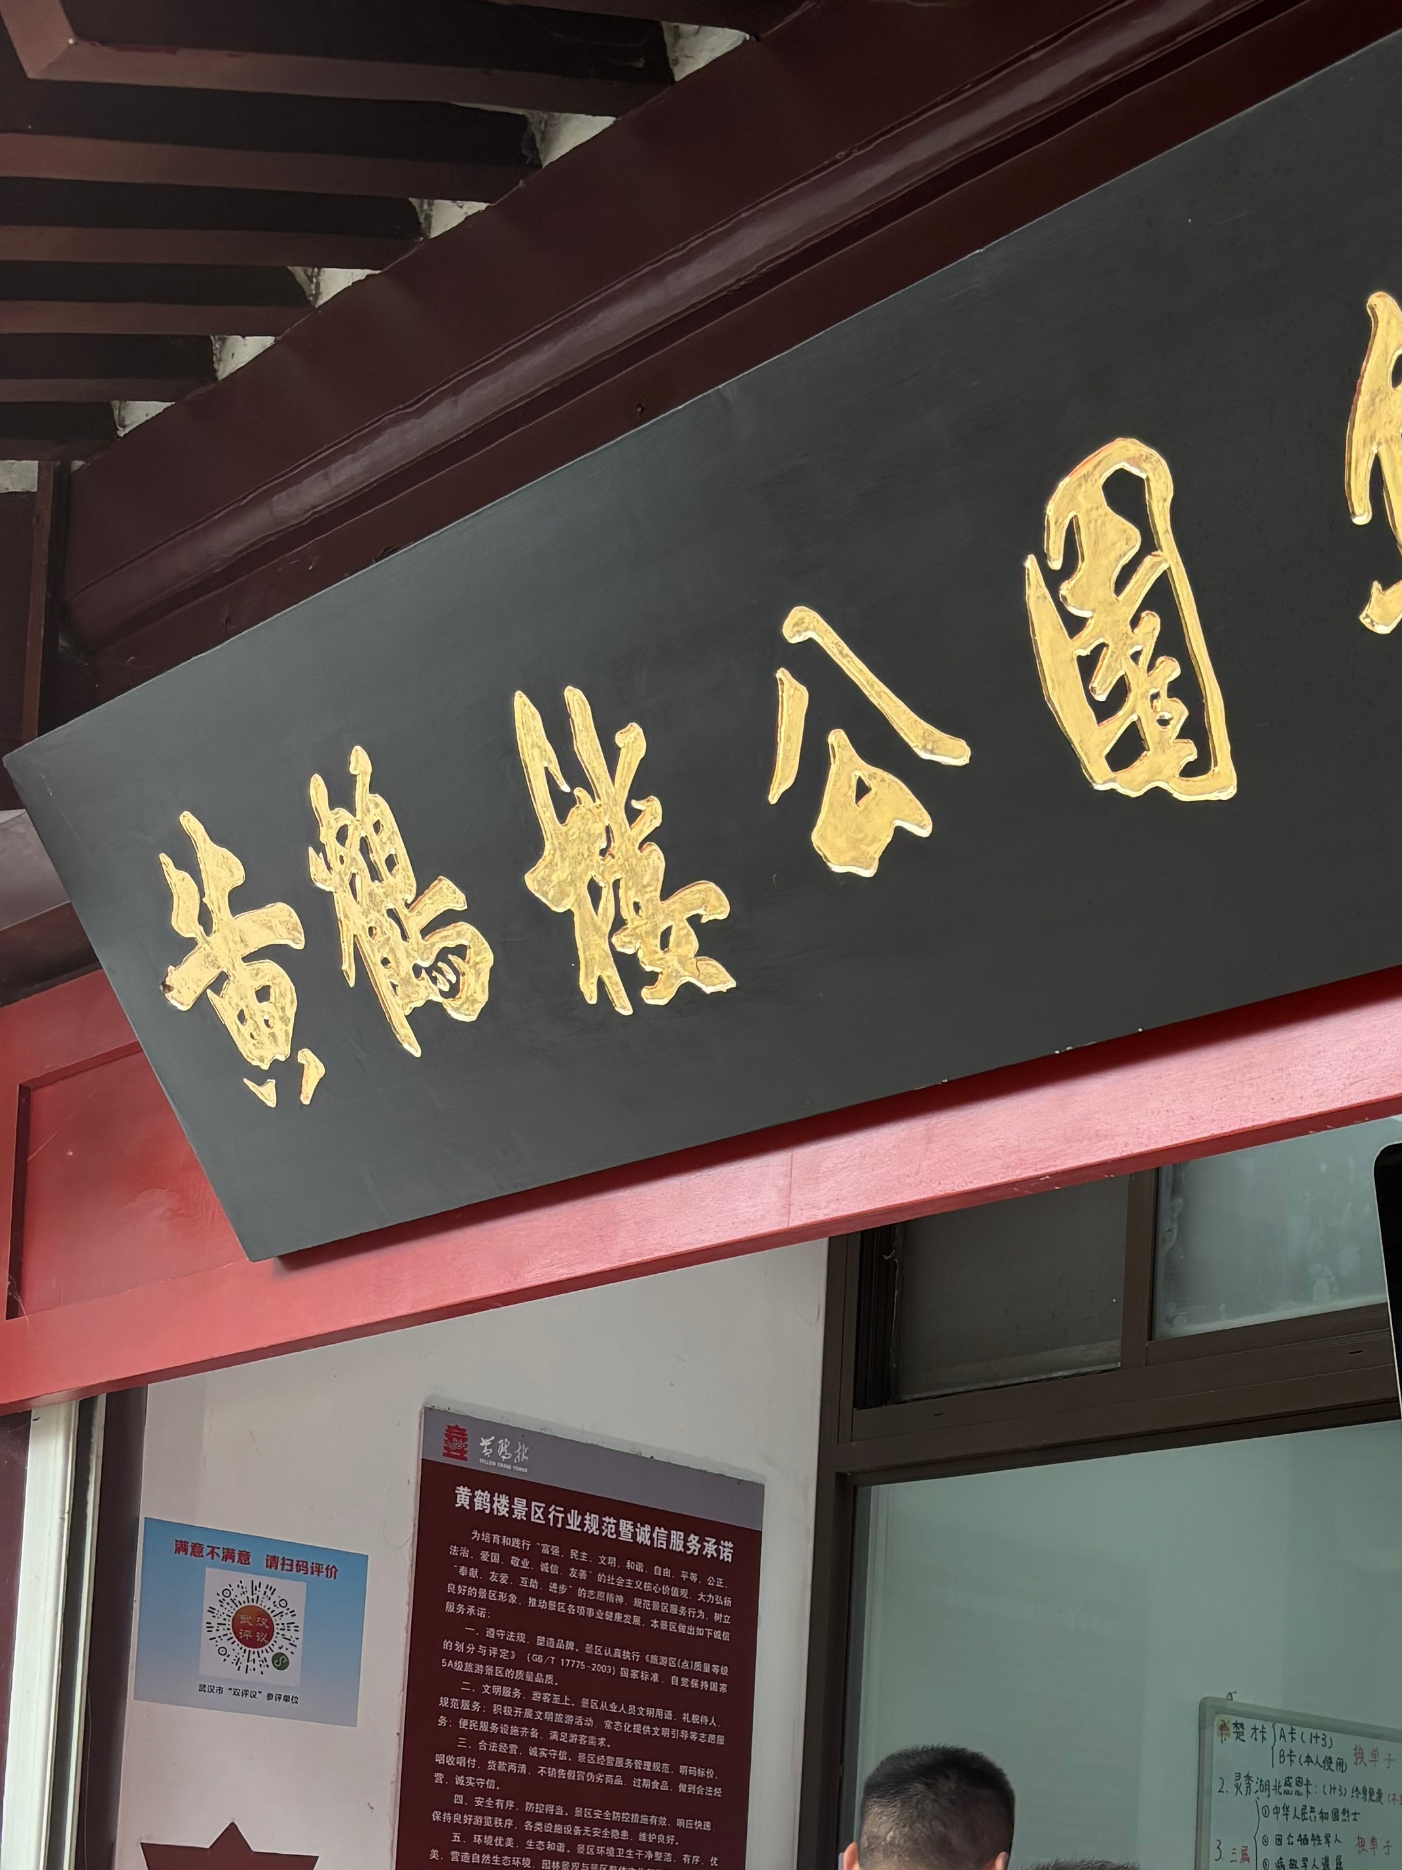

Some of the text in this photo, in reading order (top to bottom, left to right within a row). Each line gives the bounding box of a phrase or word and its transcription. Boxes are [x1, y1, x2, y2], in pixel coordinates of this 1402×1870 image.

[453, 1484, 734, 1564] 黄鹤楼景区行业规范暨诚信服务承诺
[174, 1540, 339, 1580] 满意不满意 请扫码评价
